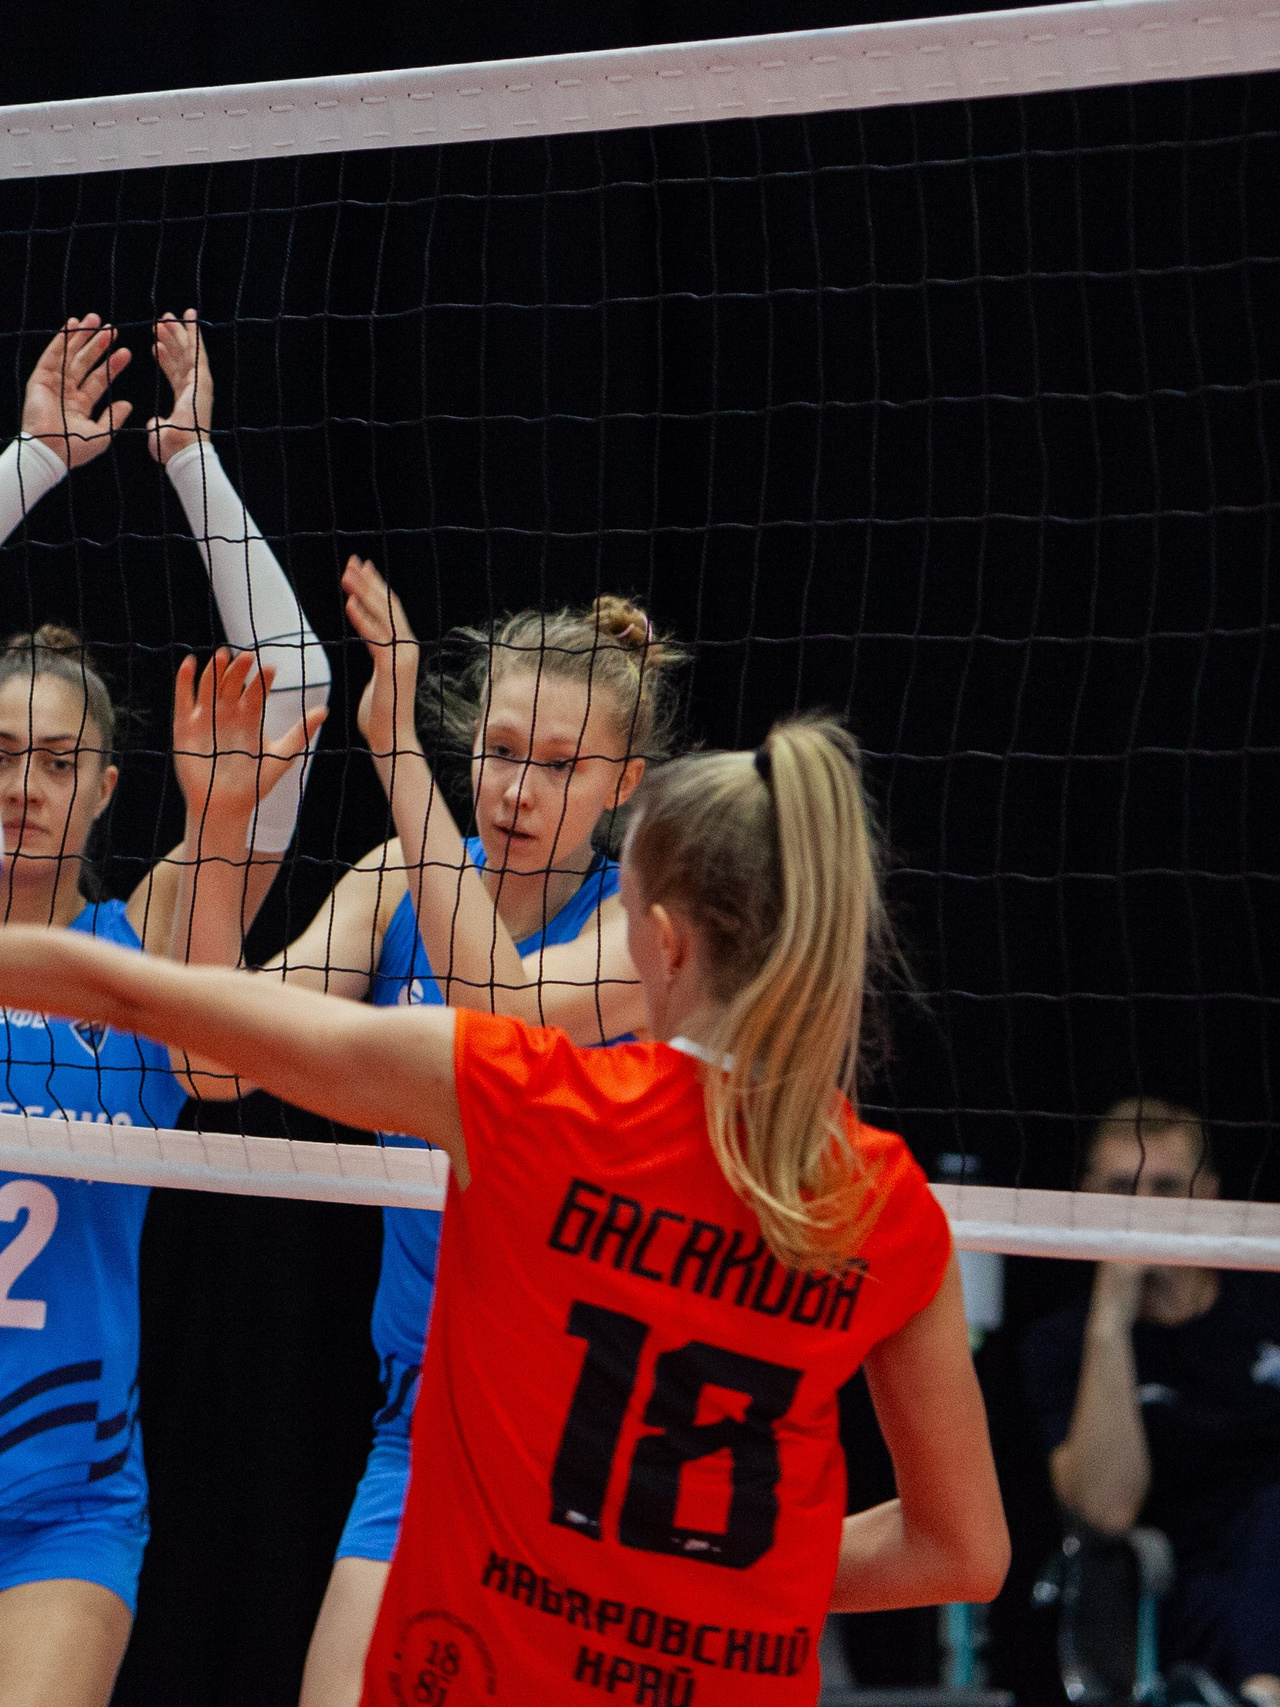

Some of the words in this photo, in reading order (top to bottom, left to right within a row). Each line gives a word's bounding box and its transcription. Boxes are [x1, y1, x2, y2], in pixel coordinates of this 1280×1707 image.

[547, 1177, 869, 1333] БАСАКОВА
[550, 1300, 805, 1571] 18
[481, 1549, 810, 1678] ХАБАРОВСКИЙ
[574, 1645, 696, 1707] КРАЙ
